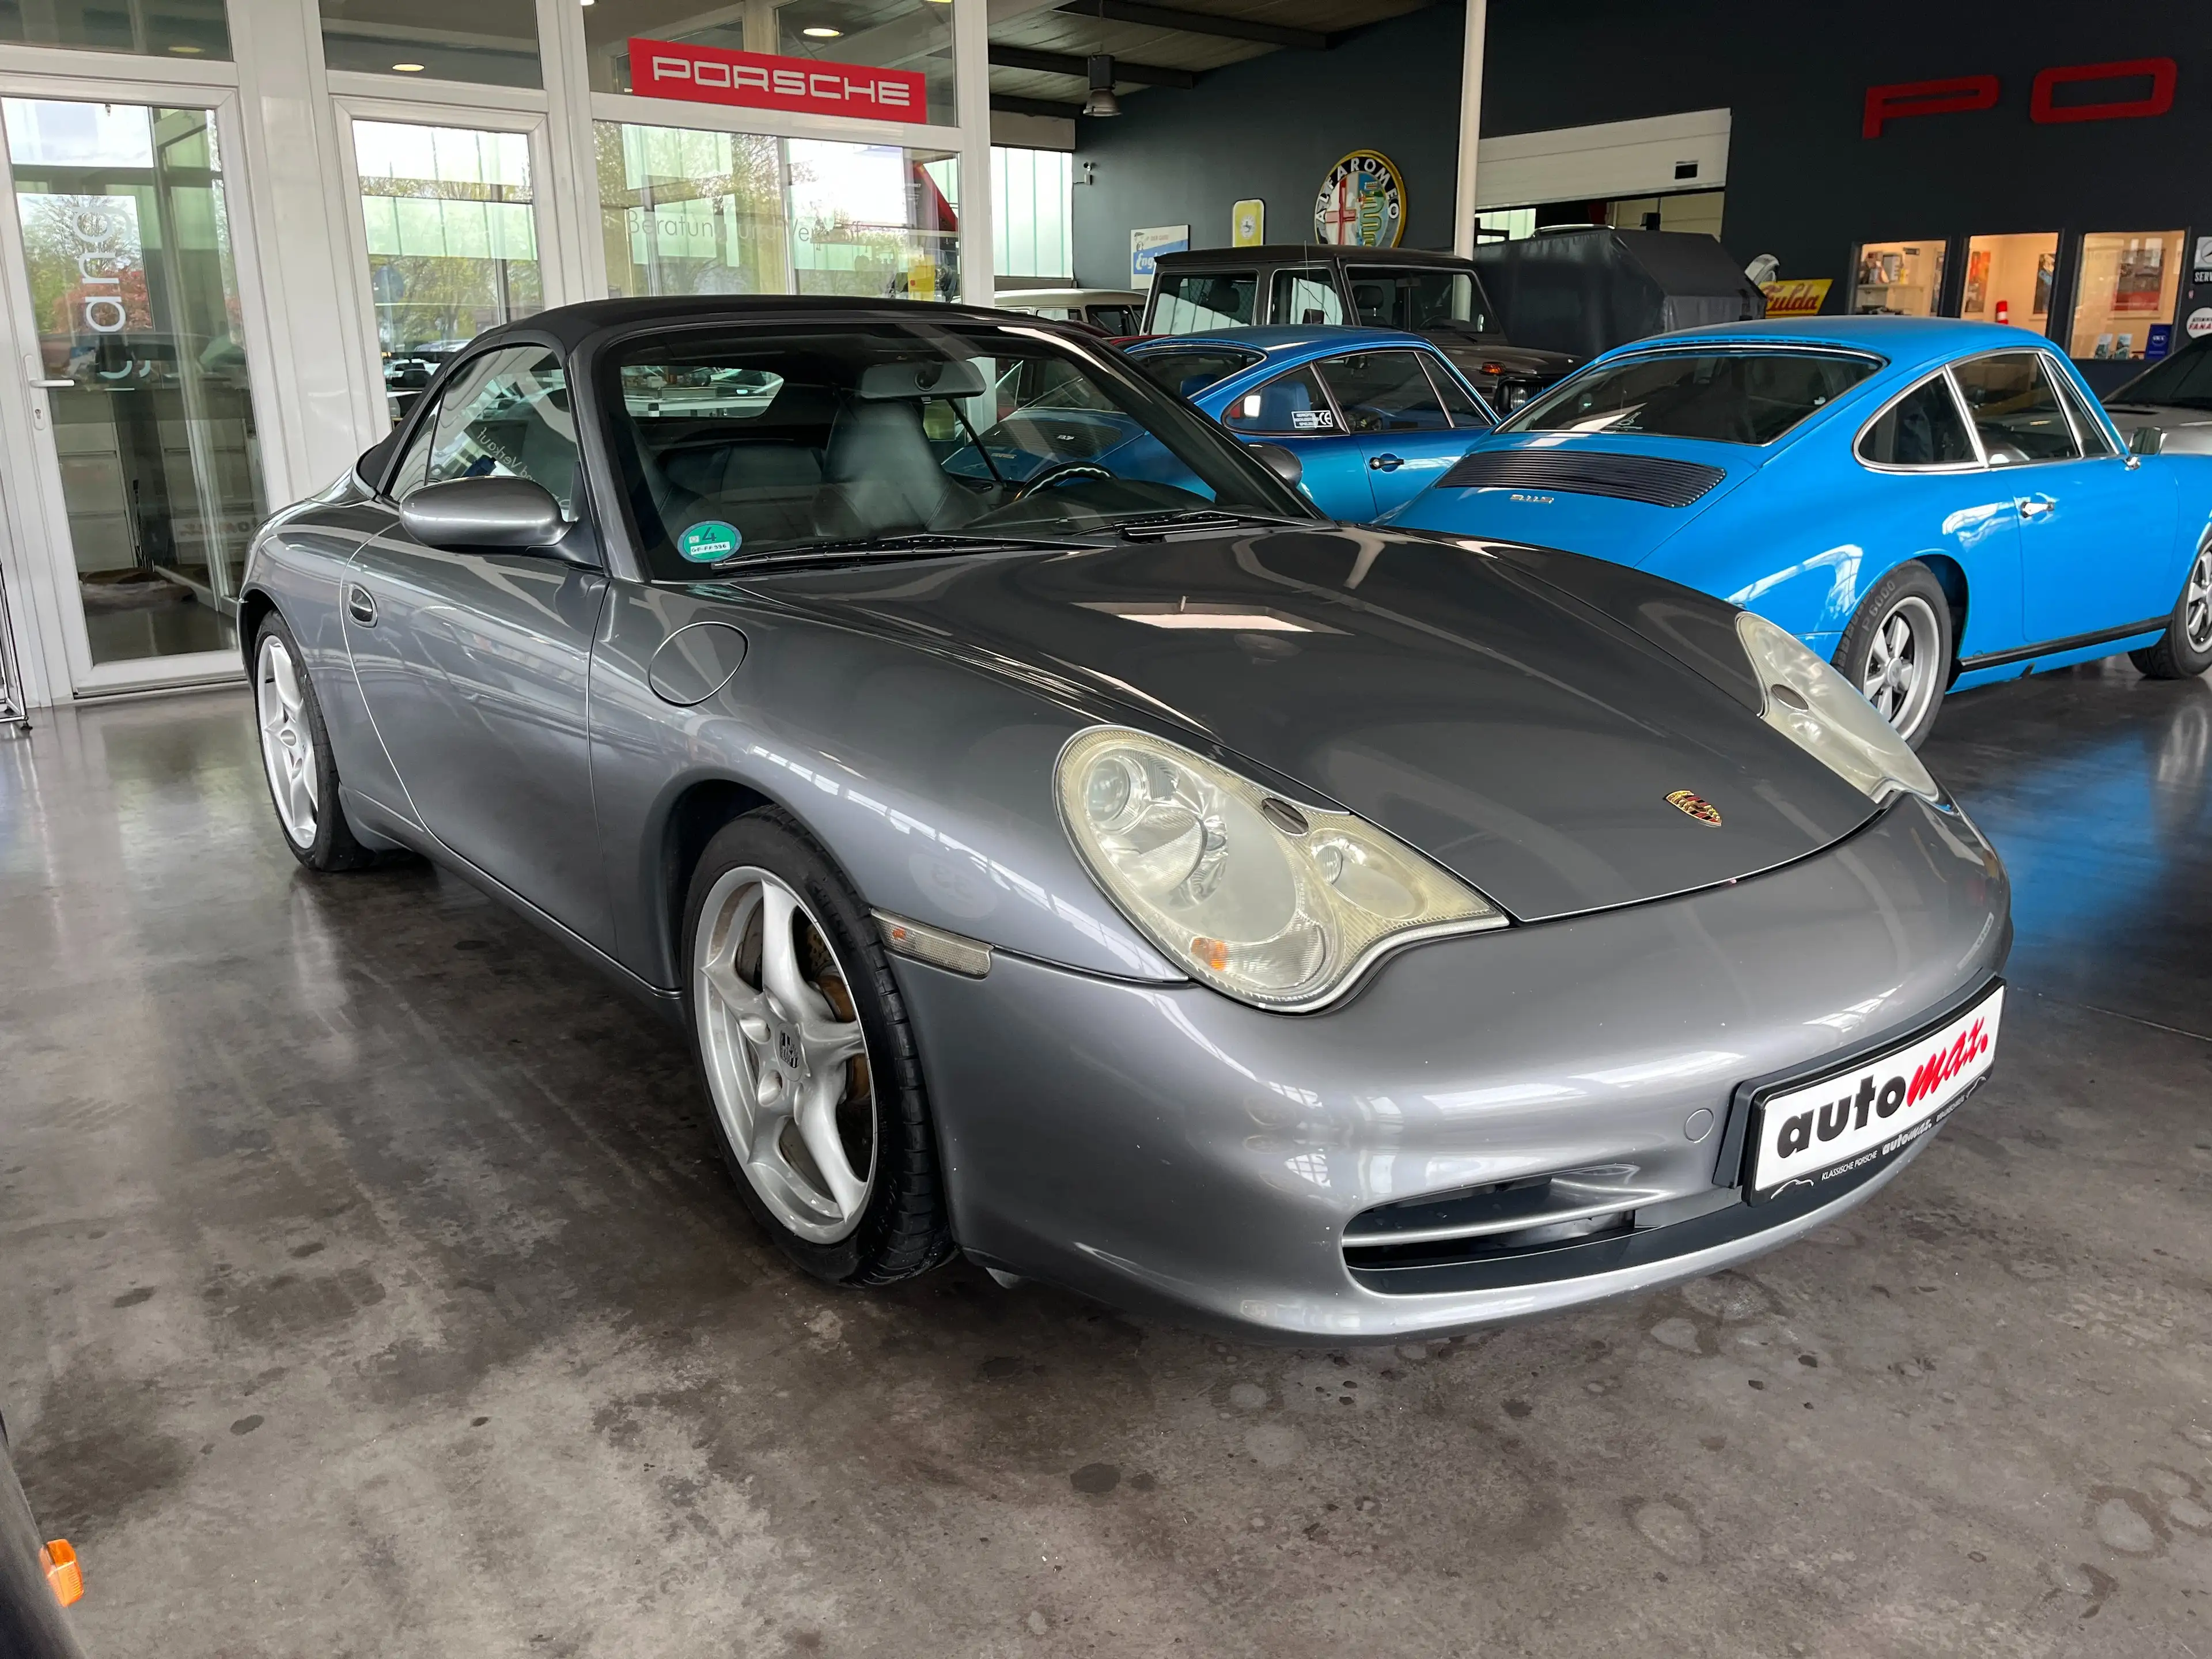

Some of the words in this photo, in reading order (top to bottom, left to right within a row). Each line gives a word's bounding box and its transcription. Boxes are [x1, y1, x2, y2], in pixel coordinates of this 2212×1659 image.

[652, 56, 910, 106] PORSCHE
[1862, 57, 2177, 139] PO
[1763, 283, 1820, 312] Fulda
[702, 527, 717, 541] 4
[1821, 1161, 1854, 1181] KLASSISCHE
[1854, 1150, 1878, 1168] PORSCHE
